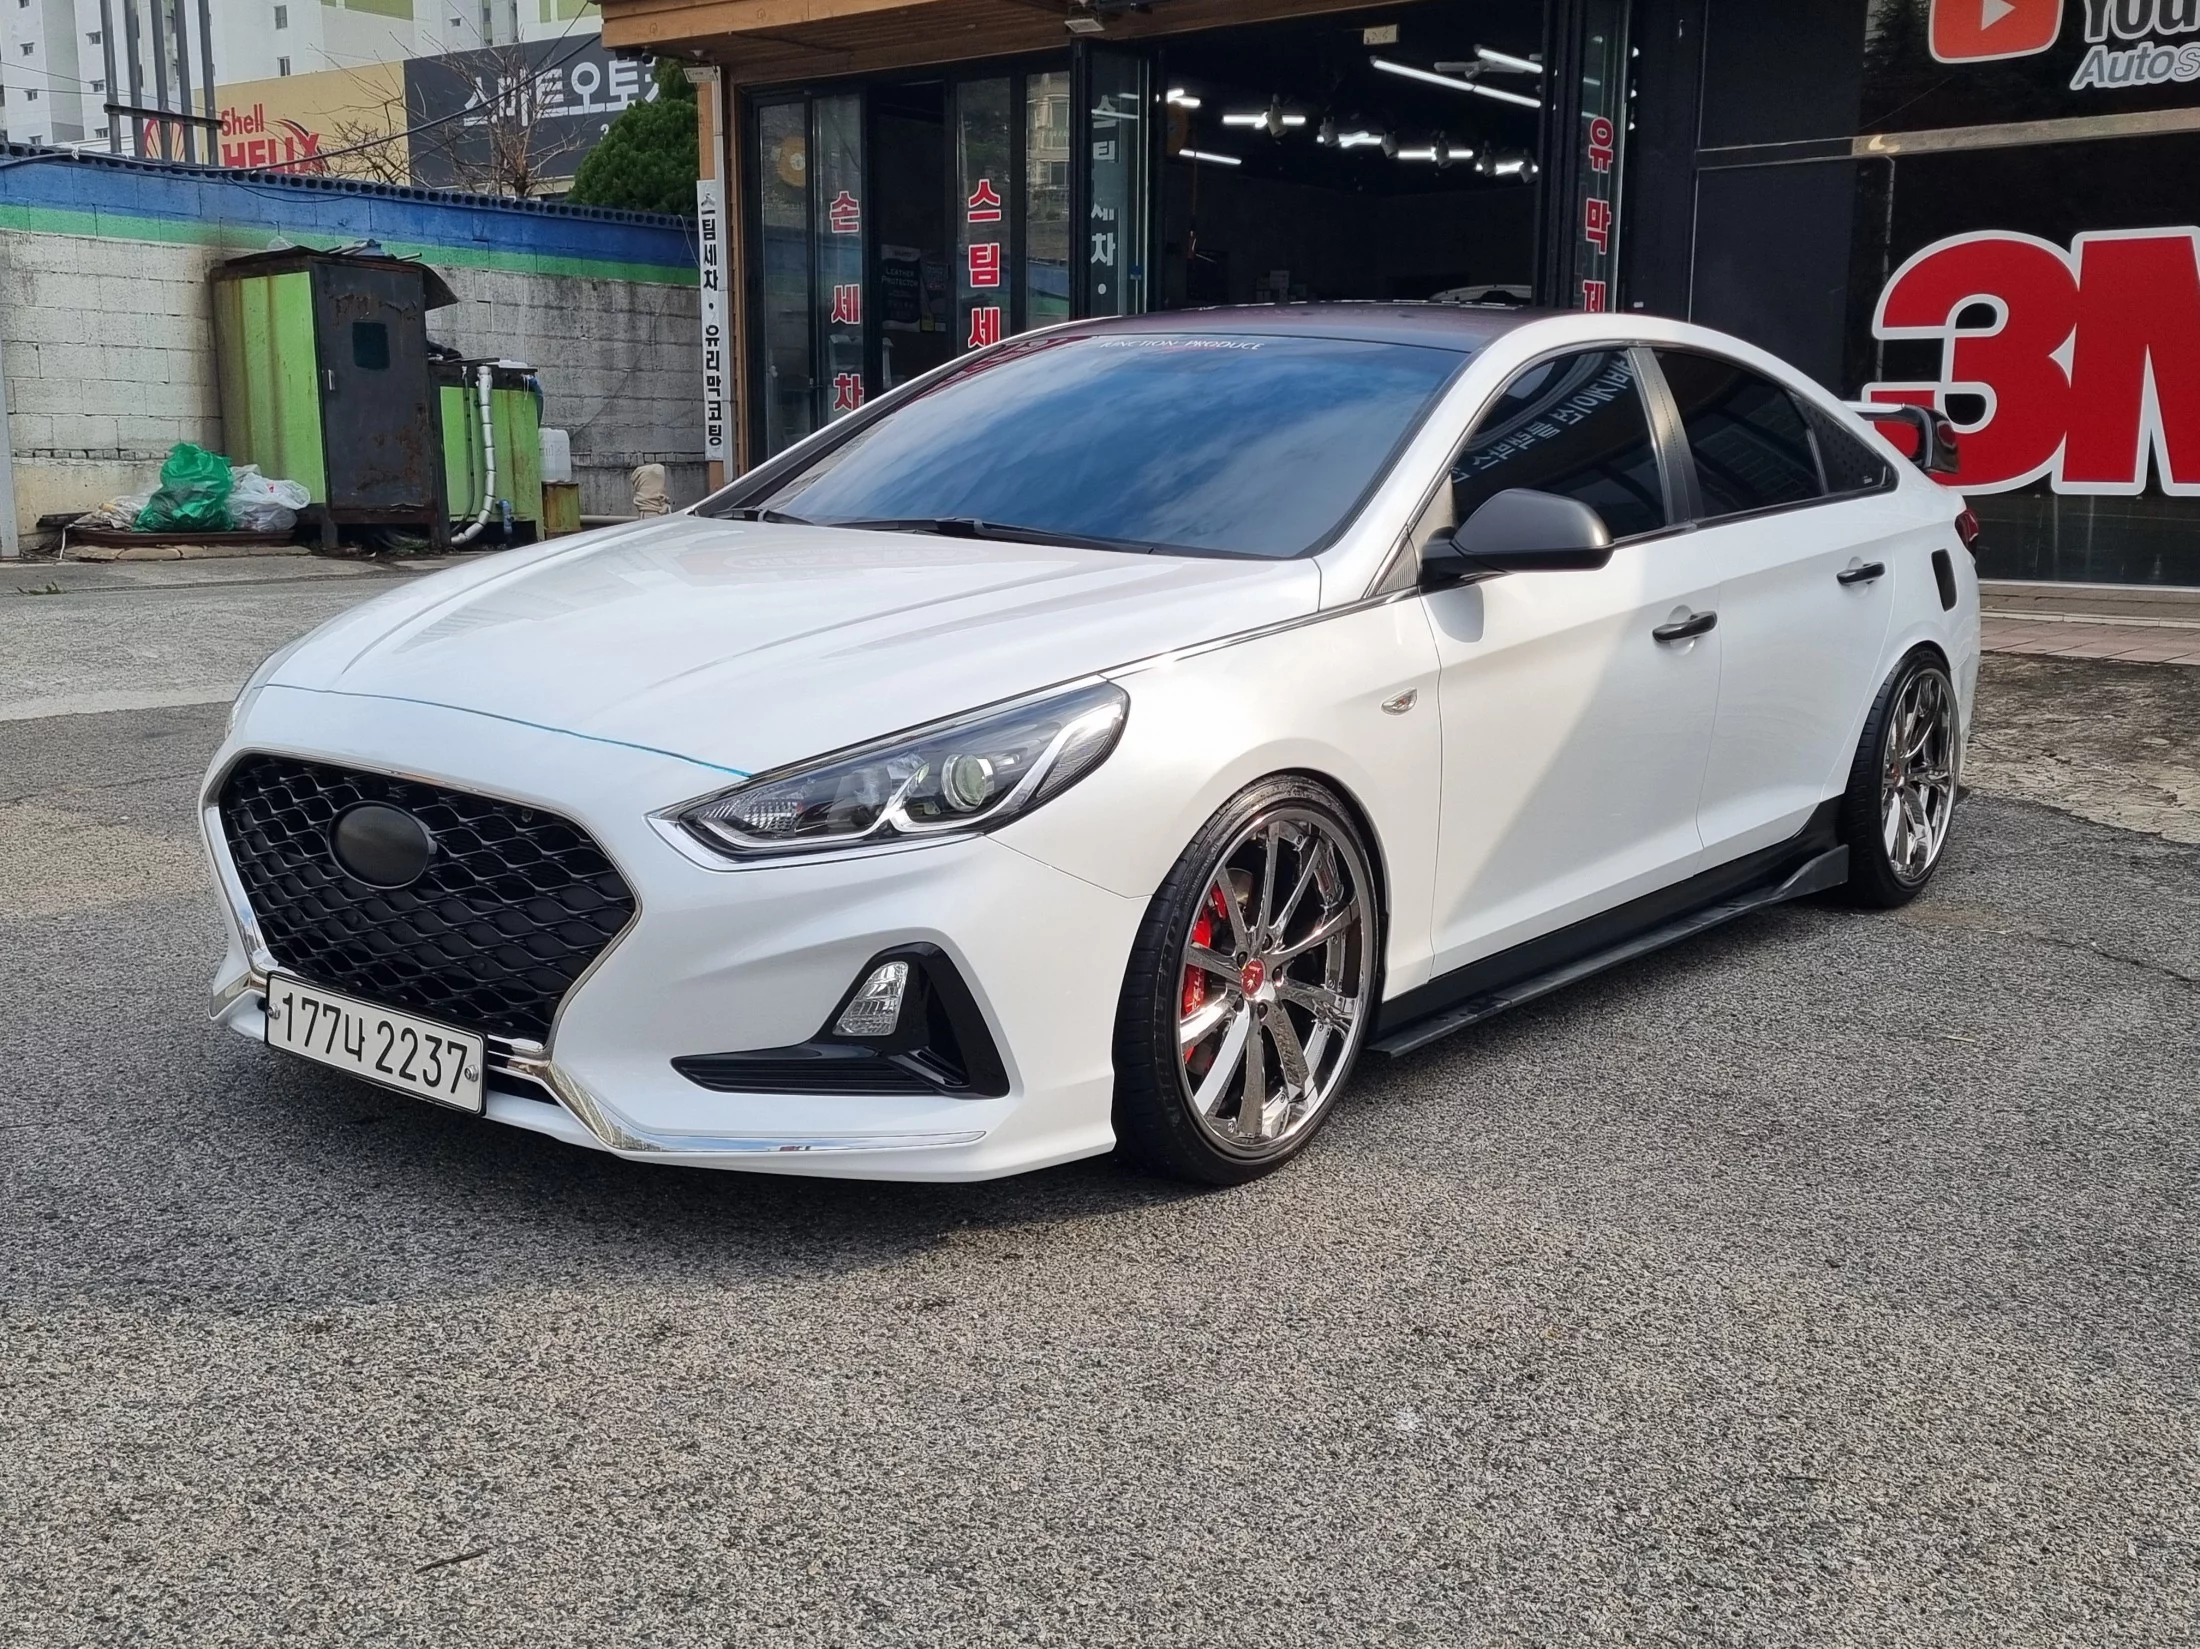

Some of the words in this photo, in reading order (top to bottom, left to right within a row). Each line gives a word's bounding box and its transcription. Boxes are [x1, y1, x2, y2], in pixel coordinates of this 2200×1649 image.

[221, 103, 264, 136] Shell
[222, 122, 325, 174] HELIX
[700, 193, 719, 291] 스팀세차
[829, 190, 864, 412] 손세차
[705, 324, 723, 447] 유리막코팅
[282, 992, 366, 1062] 177나
[375, 1020, 468, 1094] 2237
